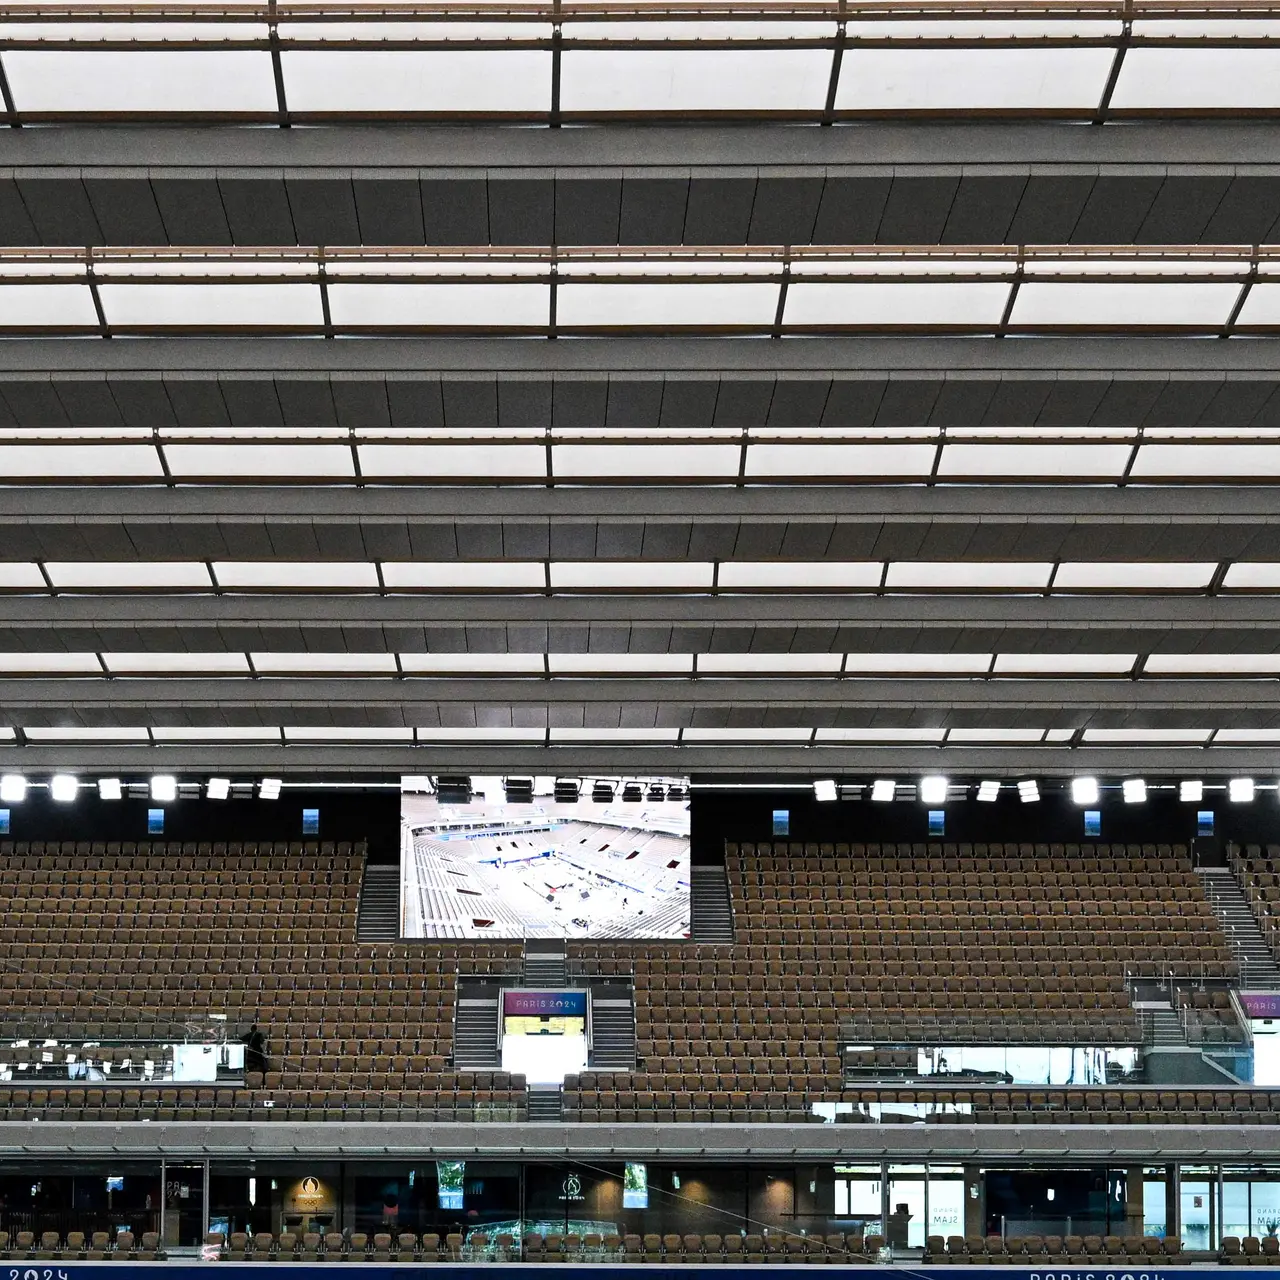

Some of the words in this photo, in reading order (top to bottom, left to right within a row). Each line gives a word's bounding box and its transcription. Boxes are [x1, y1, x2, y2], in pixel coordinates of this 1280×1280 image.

[516, 1000, 546, 1008] PARIS
[549, 1000, 577, 1008] 2024
[1246, 1002, 1276, 1010] PARIS
